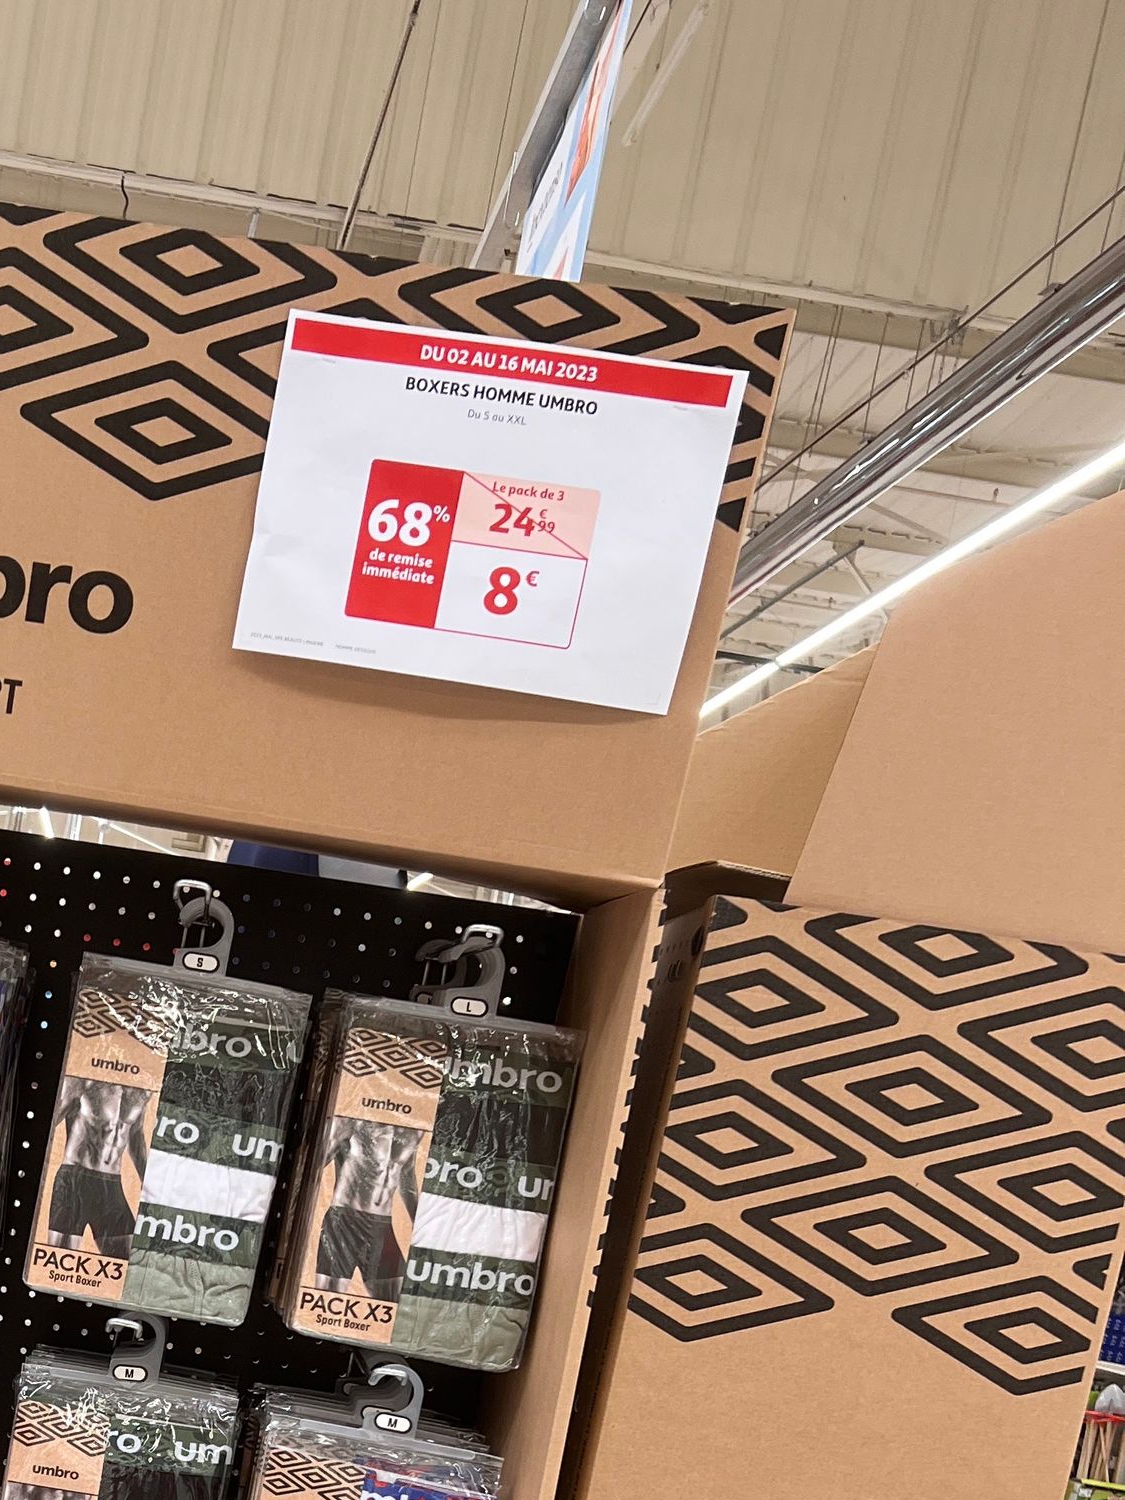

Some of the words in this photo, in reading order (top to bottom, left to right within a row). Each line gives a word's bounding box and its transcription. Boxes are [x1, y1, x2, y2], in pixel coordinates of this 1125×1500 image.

[420, 345, 445, 361] DU
[447, 348, 468, 364] 02
[471, 351, 496, 368] AU
[498, 354, 518, 371] 16
[521, 357, 553, 376] MAI
[555, 362, 598, 382] 2023
[405, 376, 470, 397] BOXERS
[474, 385, 536, 406] HOMME
[539, 394, 597, 415] UMBRO
[467, 409, 481, 419] Du
[483, 411, 489, 420] S
[492, 413, 504, 422] au
[506, 415, 526, 425] XXL
[493, 481, 506, 493] Le
[508, 485, 537, 498] pack
[540, 488, 554, 499] de
[557, 491, 565, 501] 3
[369, 548, 386, 561] de
[388, 553, 433, 568] remise
[362, 563, 435, 584] immédiate
[197, 958, 203, 968] S
[465, 1002, 471, 1012] L
[91, 1056, 140, 1076] umbro
[361, 1097, 411, 1115] umbro
[33, 1249, 90, 1274] PACK
[95, 1260, 123, 1280] X3
[49, 1269, 74, 1284] Sport
[76, 1273, 101, 1288] Boxer
[406, 1259, 534, 1296] umbro
[300, 1292, 359, 1316] PACK
[364, 1304, 393, 1324] X3
[316, 1313, 343, 1327] Sport
[344, 1317, 370, 1332] Boxer
[125, 1368, 134, 1378] M
[388, 1418, 397, 1429] M
[32, 1464, 79, 1480] umbro
